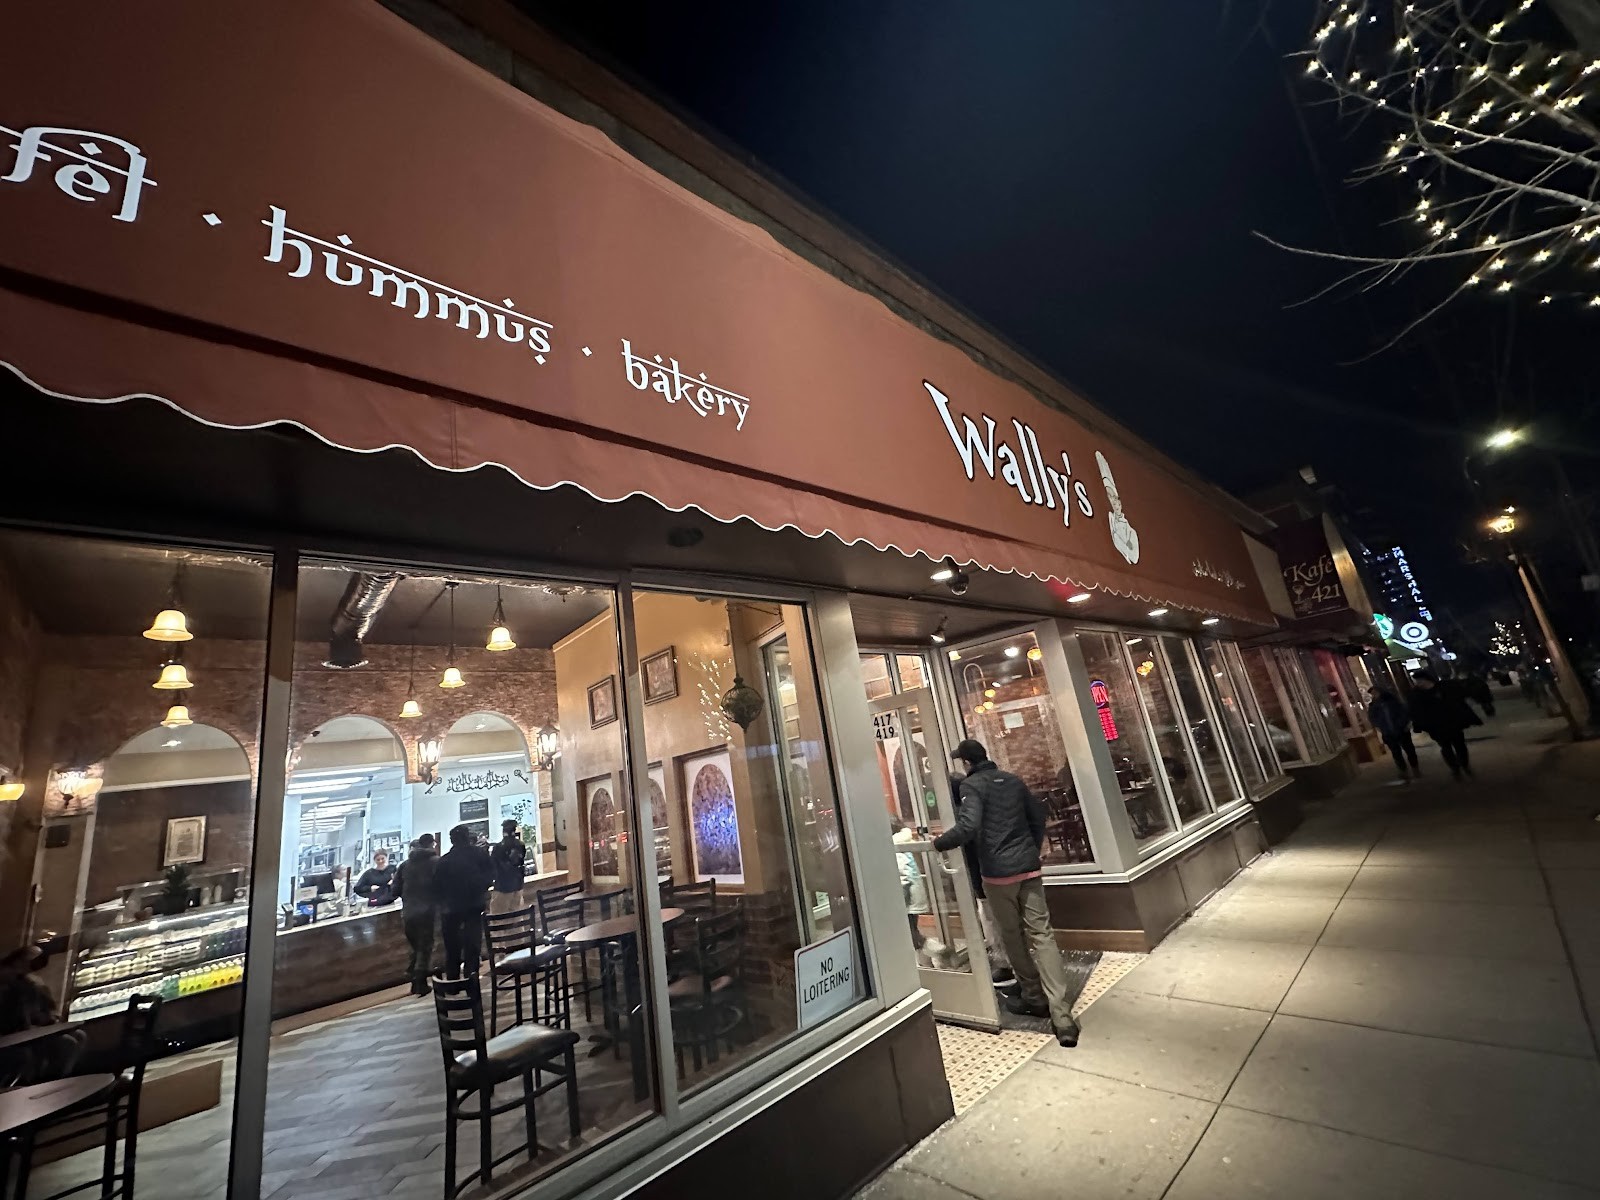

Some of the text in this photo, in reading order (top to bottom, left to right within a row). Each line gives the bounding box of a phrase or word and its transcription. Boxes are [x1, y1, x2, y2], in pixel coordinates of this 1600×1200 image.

[261, 205, 553, 365] hummus
[621, 339, 750, 431] bakery
[922, 379, 1093, 527] Wally's
[1311, 583, 1340, 602] 421
[873, 713, 891, 728] 417
[876, 726, 895, 739] 419
[820, 957, 834, 976] NO
[803, 967, 850, 1004] LOITERING
